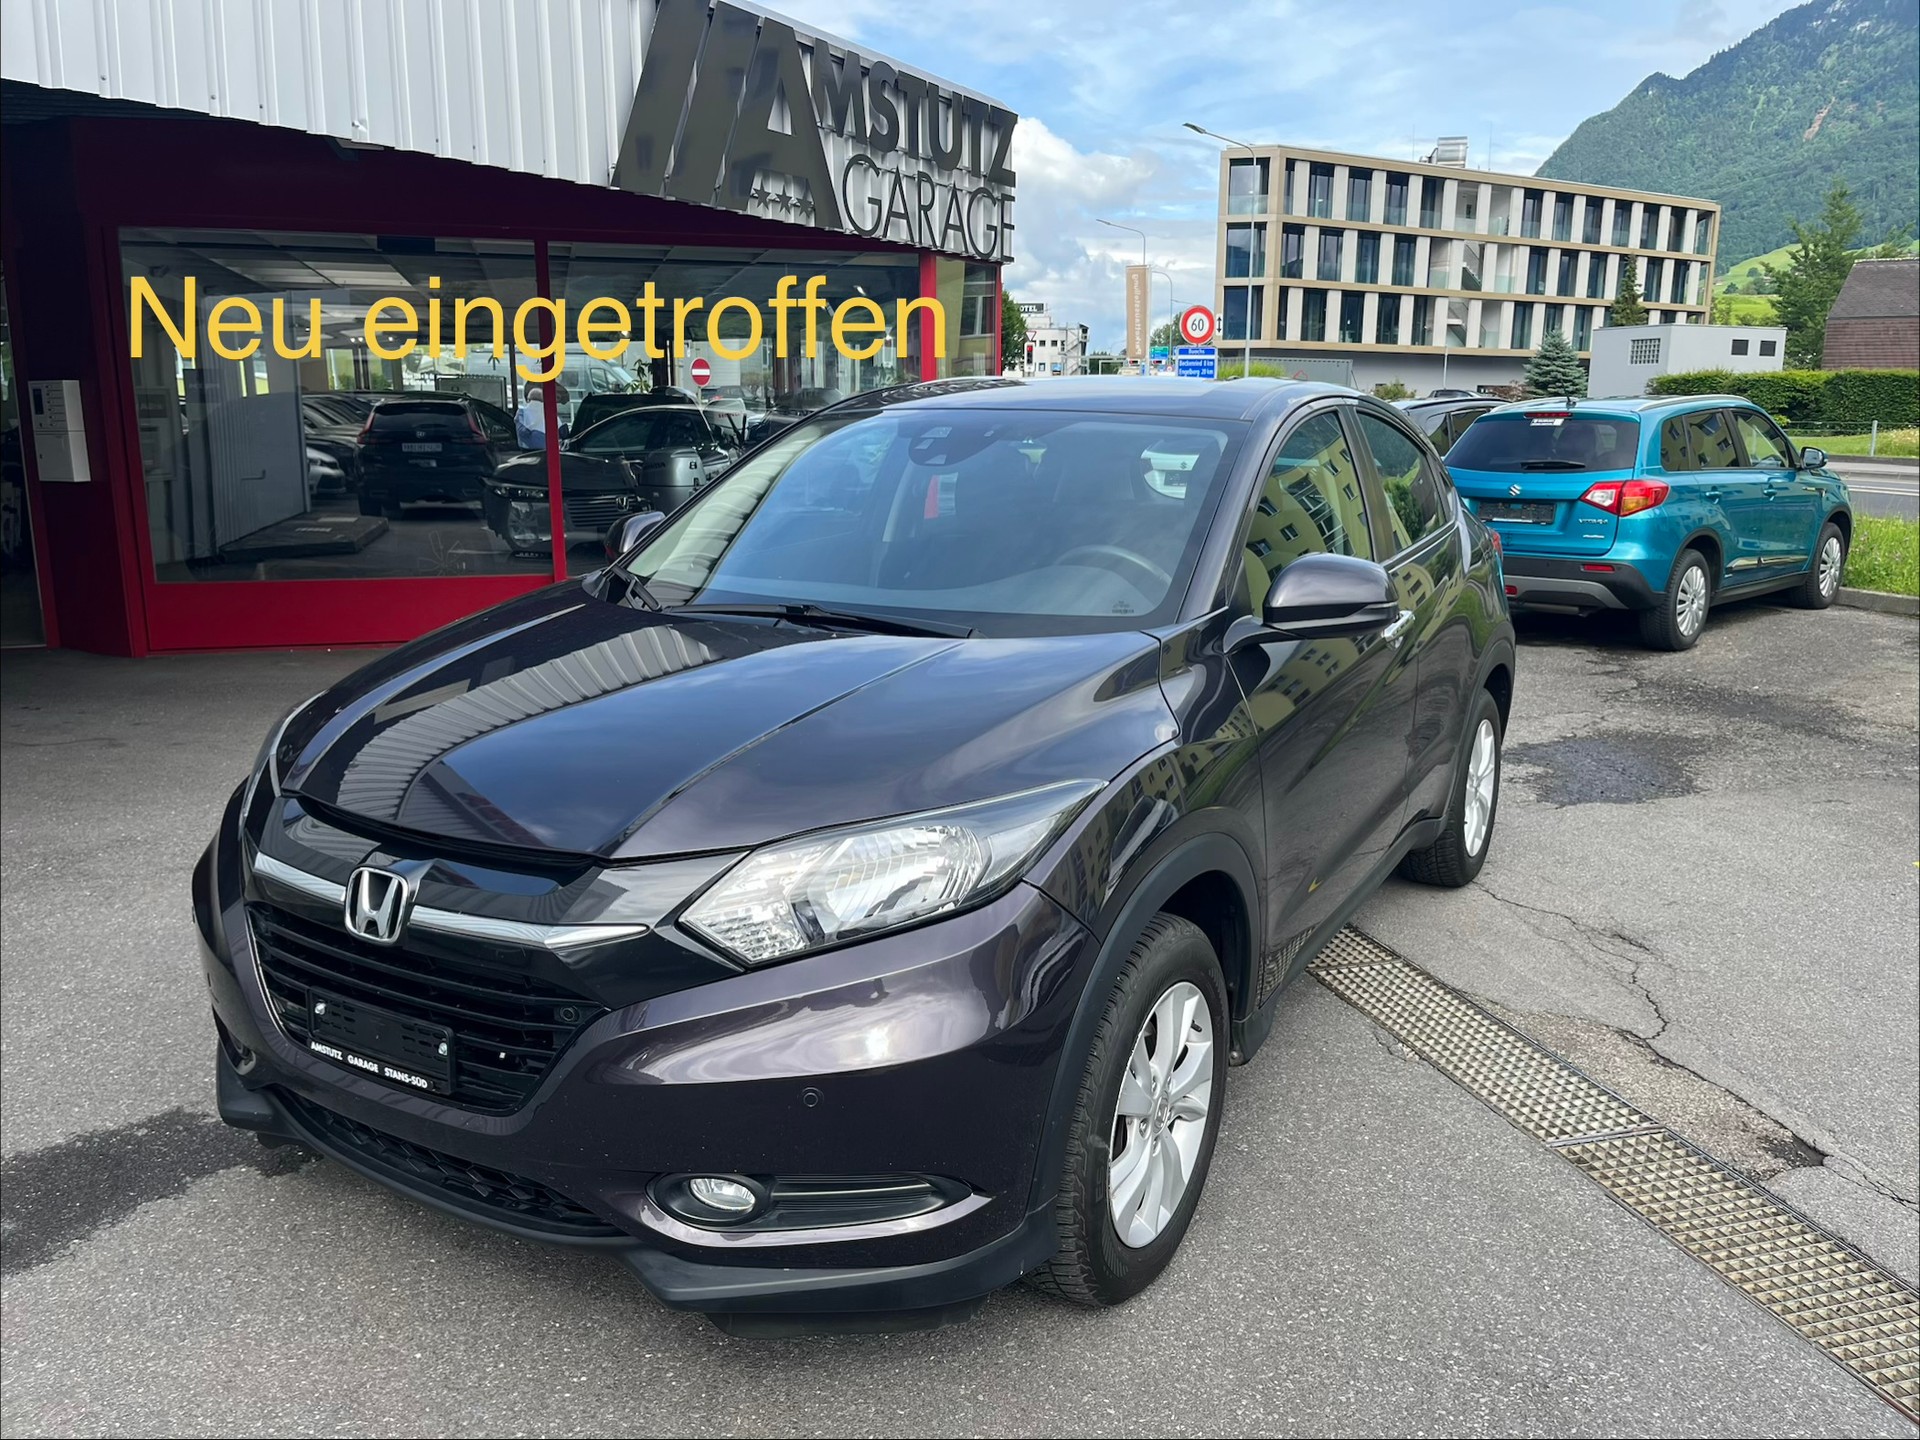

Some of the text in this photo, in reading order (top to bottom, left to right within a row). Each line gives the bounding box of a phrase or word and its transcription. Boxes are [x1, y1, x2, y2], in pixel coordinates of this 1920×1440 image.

[842, 153, 1016, 263] GARAGE
[1191, 318, 1204, 331] 60
[310, 1041, 428, 1088] AMSTUTZ GARAGE STANS-SÜD
